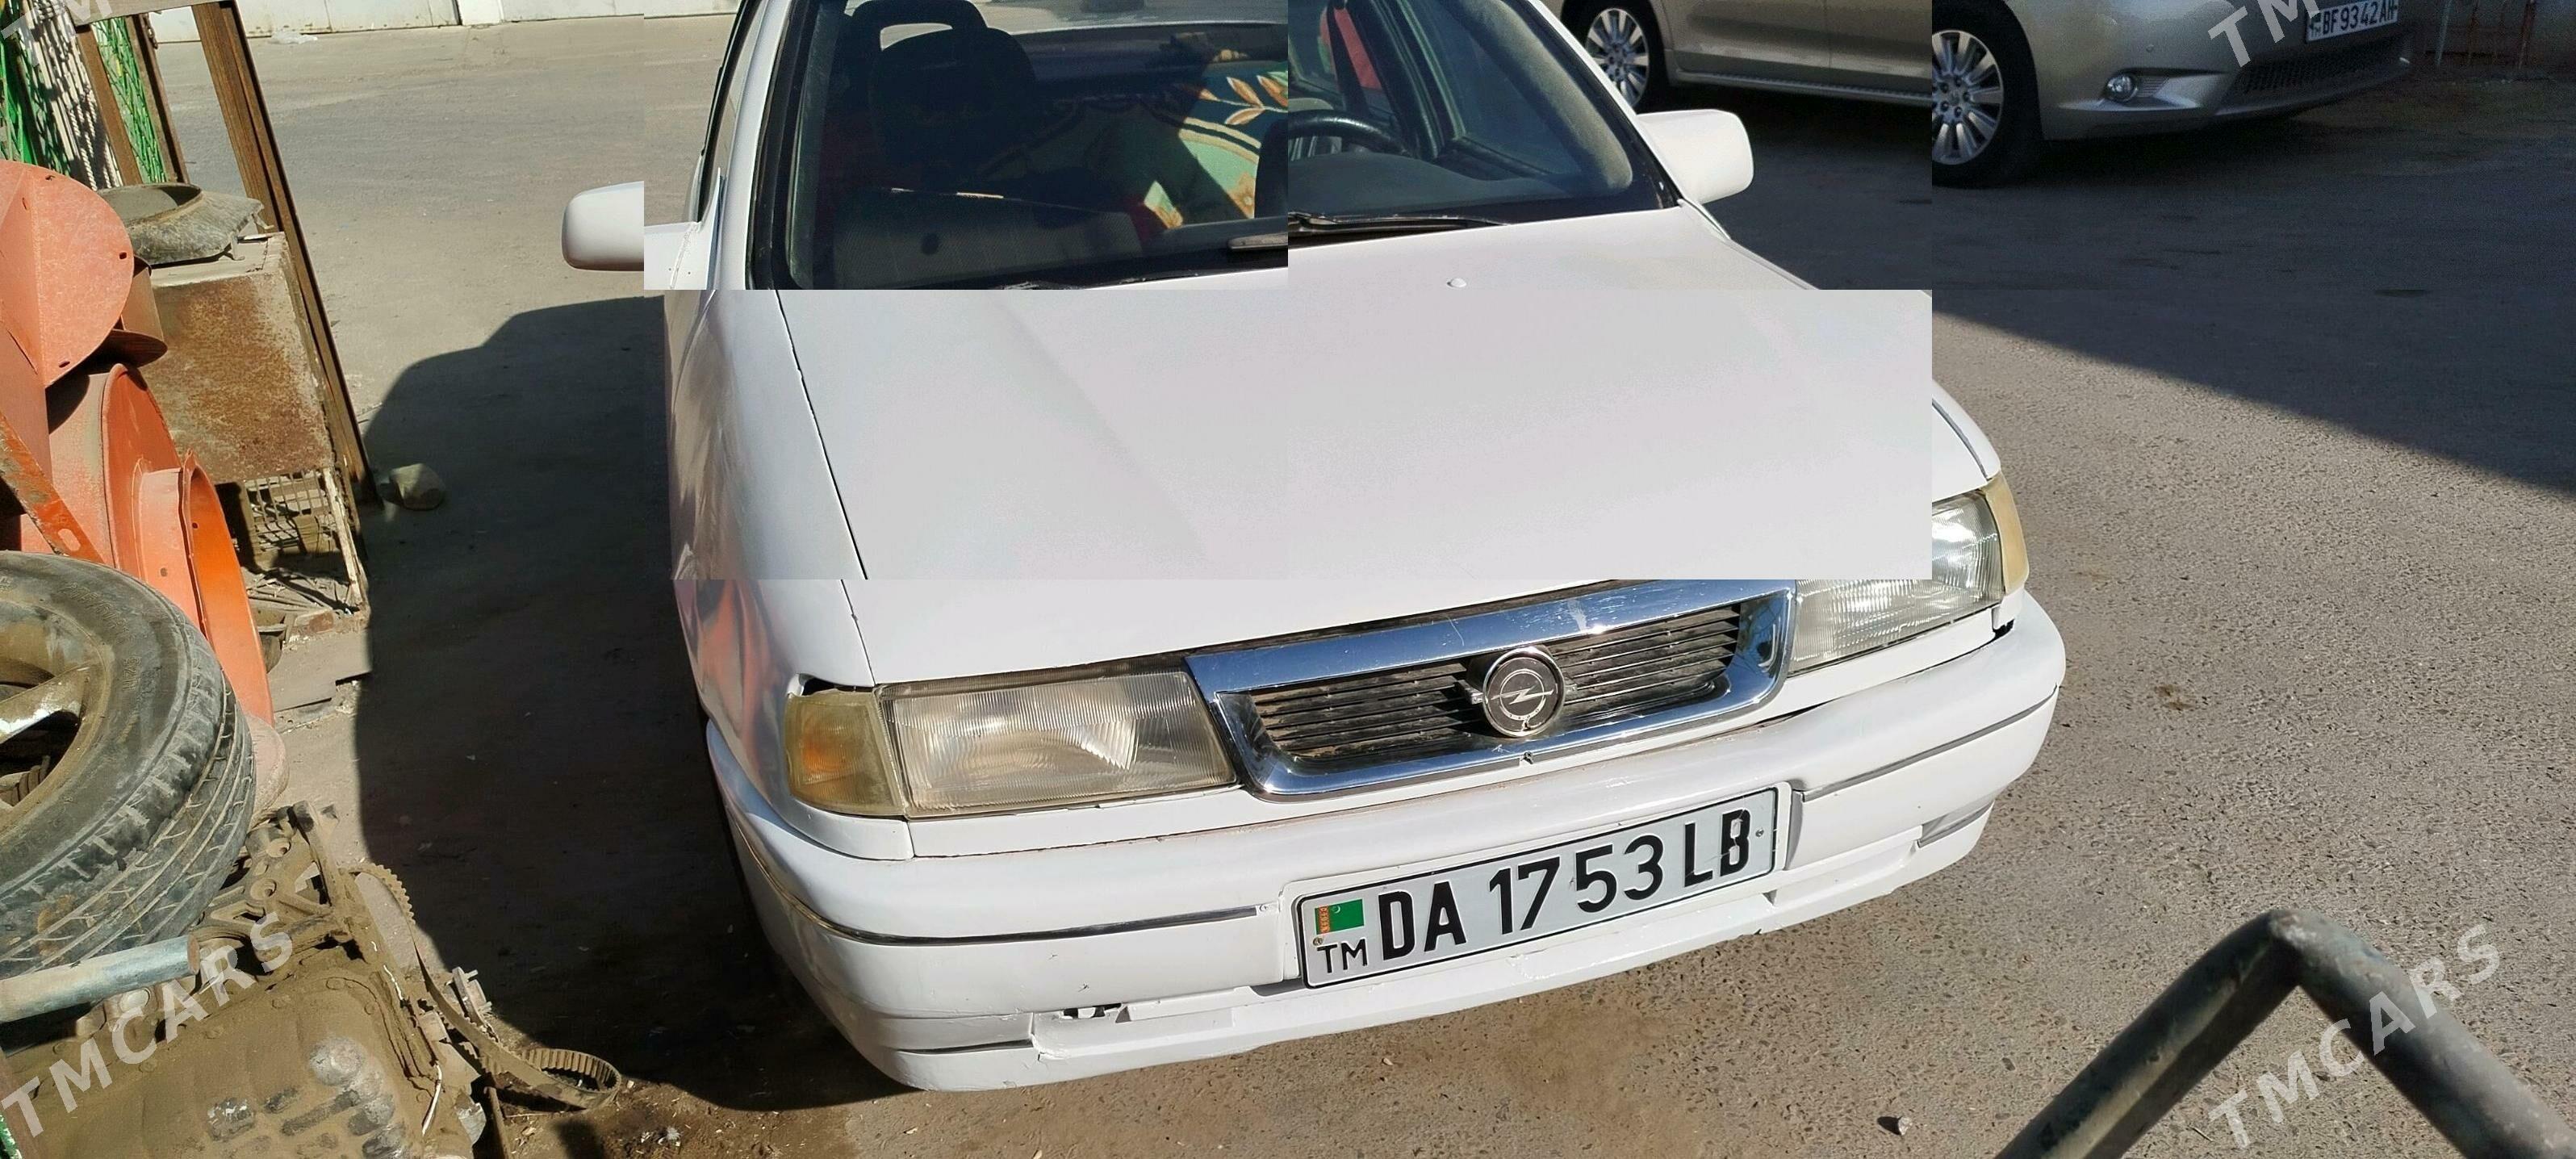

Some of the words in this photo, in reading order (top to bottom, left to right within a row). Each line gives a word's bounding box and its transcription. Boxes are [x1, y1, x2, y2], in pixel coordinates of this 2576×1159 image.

[1378, 881, 1467, 960] DA
[1489, 835, 1664, 935] 1753
[1683, 809, 1750, 887] LB
[1316, 937, 1368, 973] TM
